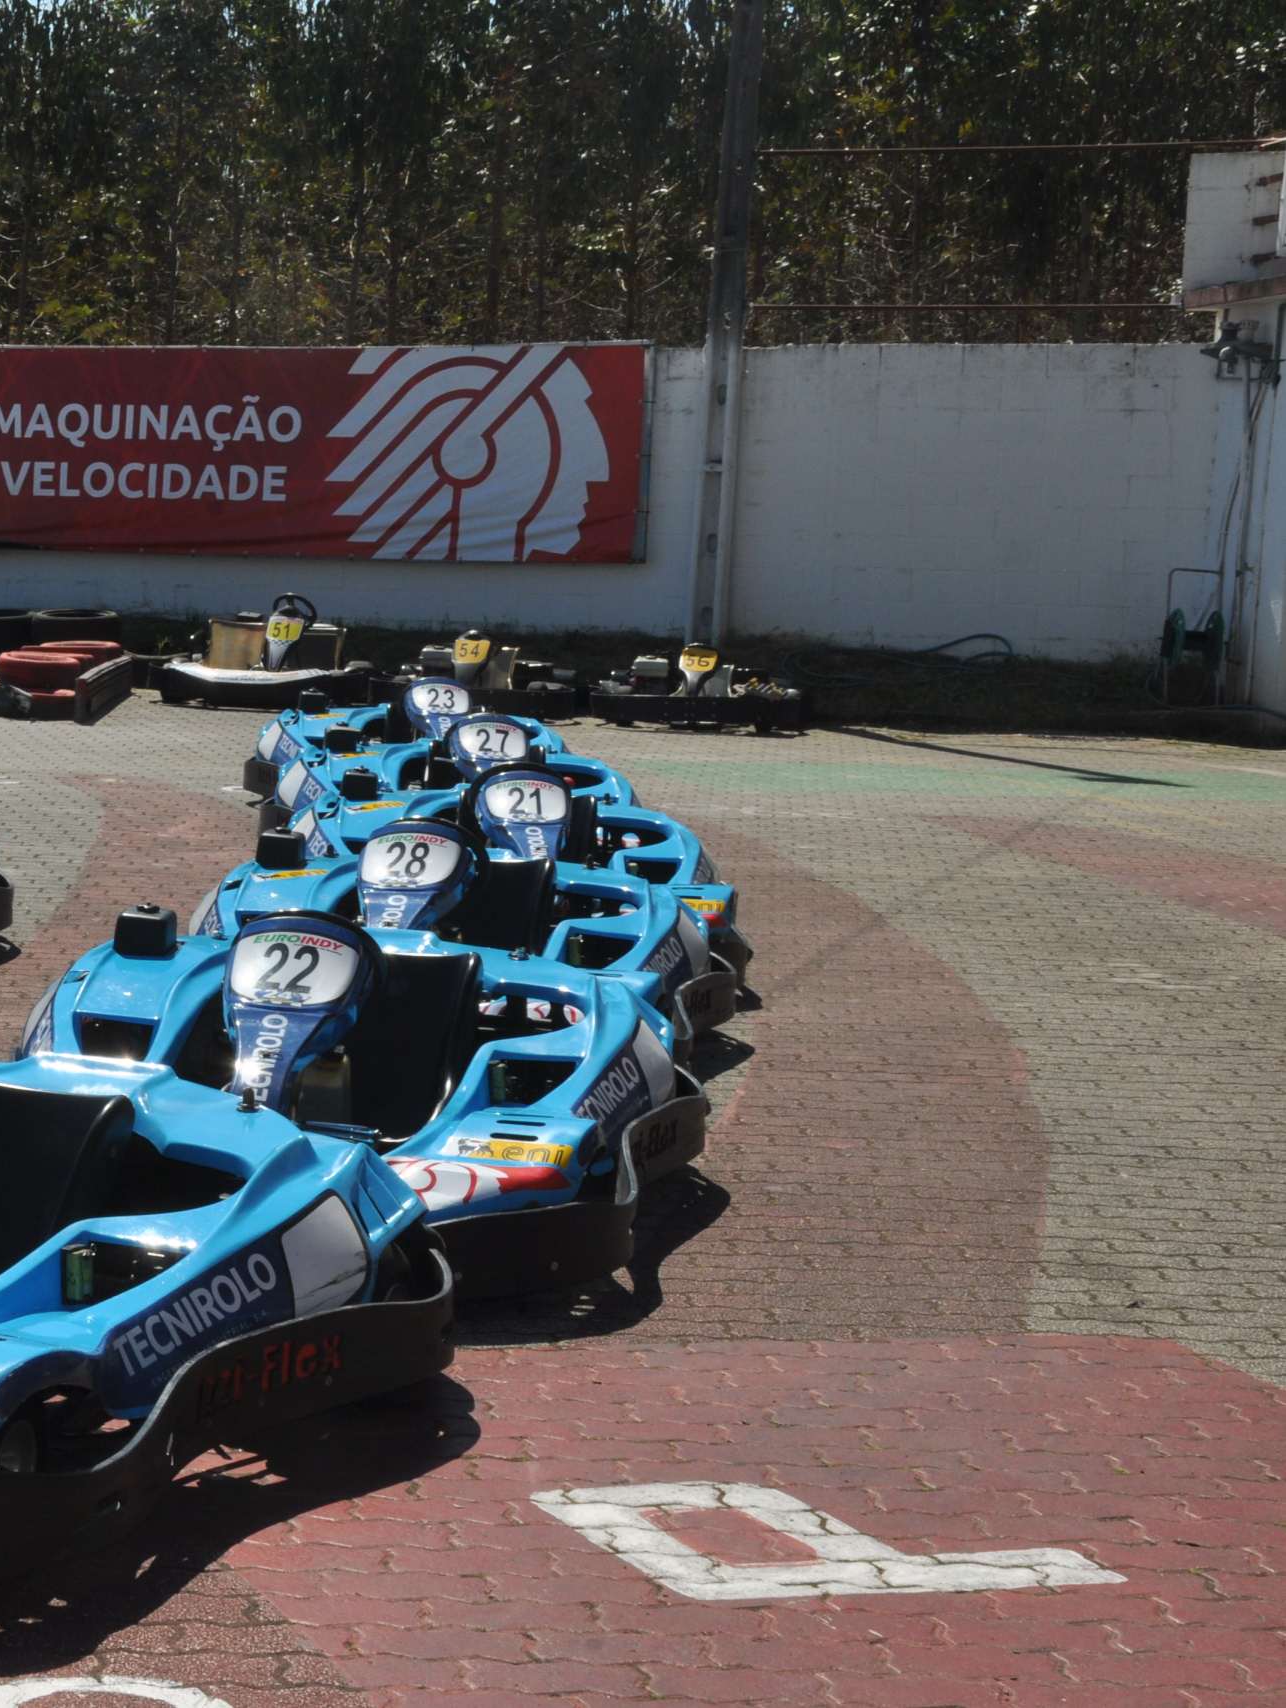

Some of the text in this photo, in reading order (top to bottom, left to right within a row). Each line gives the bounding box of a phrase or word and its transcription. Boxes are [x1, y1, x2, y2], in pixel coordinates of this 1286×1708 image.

[0, 461, 289, 502] VELOCIDADE
[272, 622, 291, 640] 51
[459, 643, 481, 658] 54
[428, 688, 455, 709] 23
[477, 728, 510, 752] 27
[508, 786, 542, 815] 21
[377, 834, 450, 845] EUROINDY
[386, 841, 430, 878] 28
[253, 933, 344, 951] EUROINDY
[255, 942, 320, 994] 22
[245, 1013, 289, 1102] ECNIROLO
[113, 1252, 277, 1377] TECNIROLO
